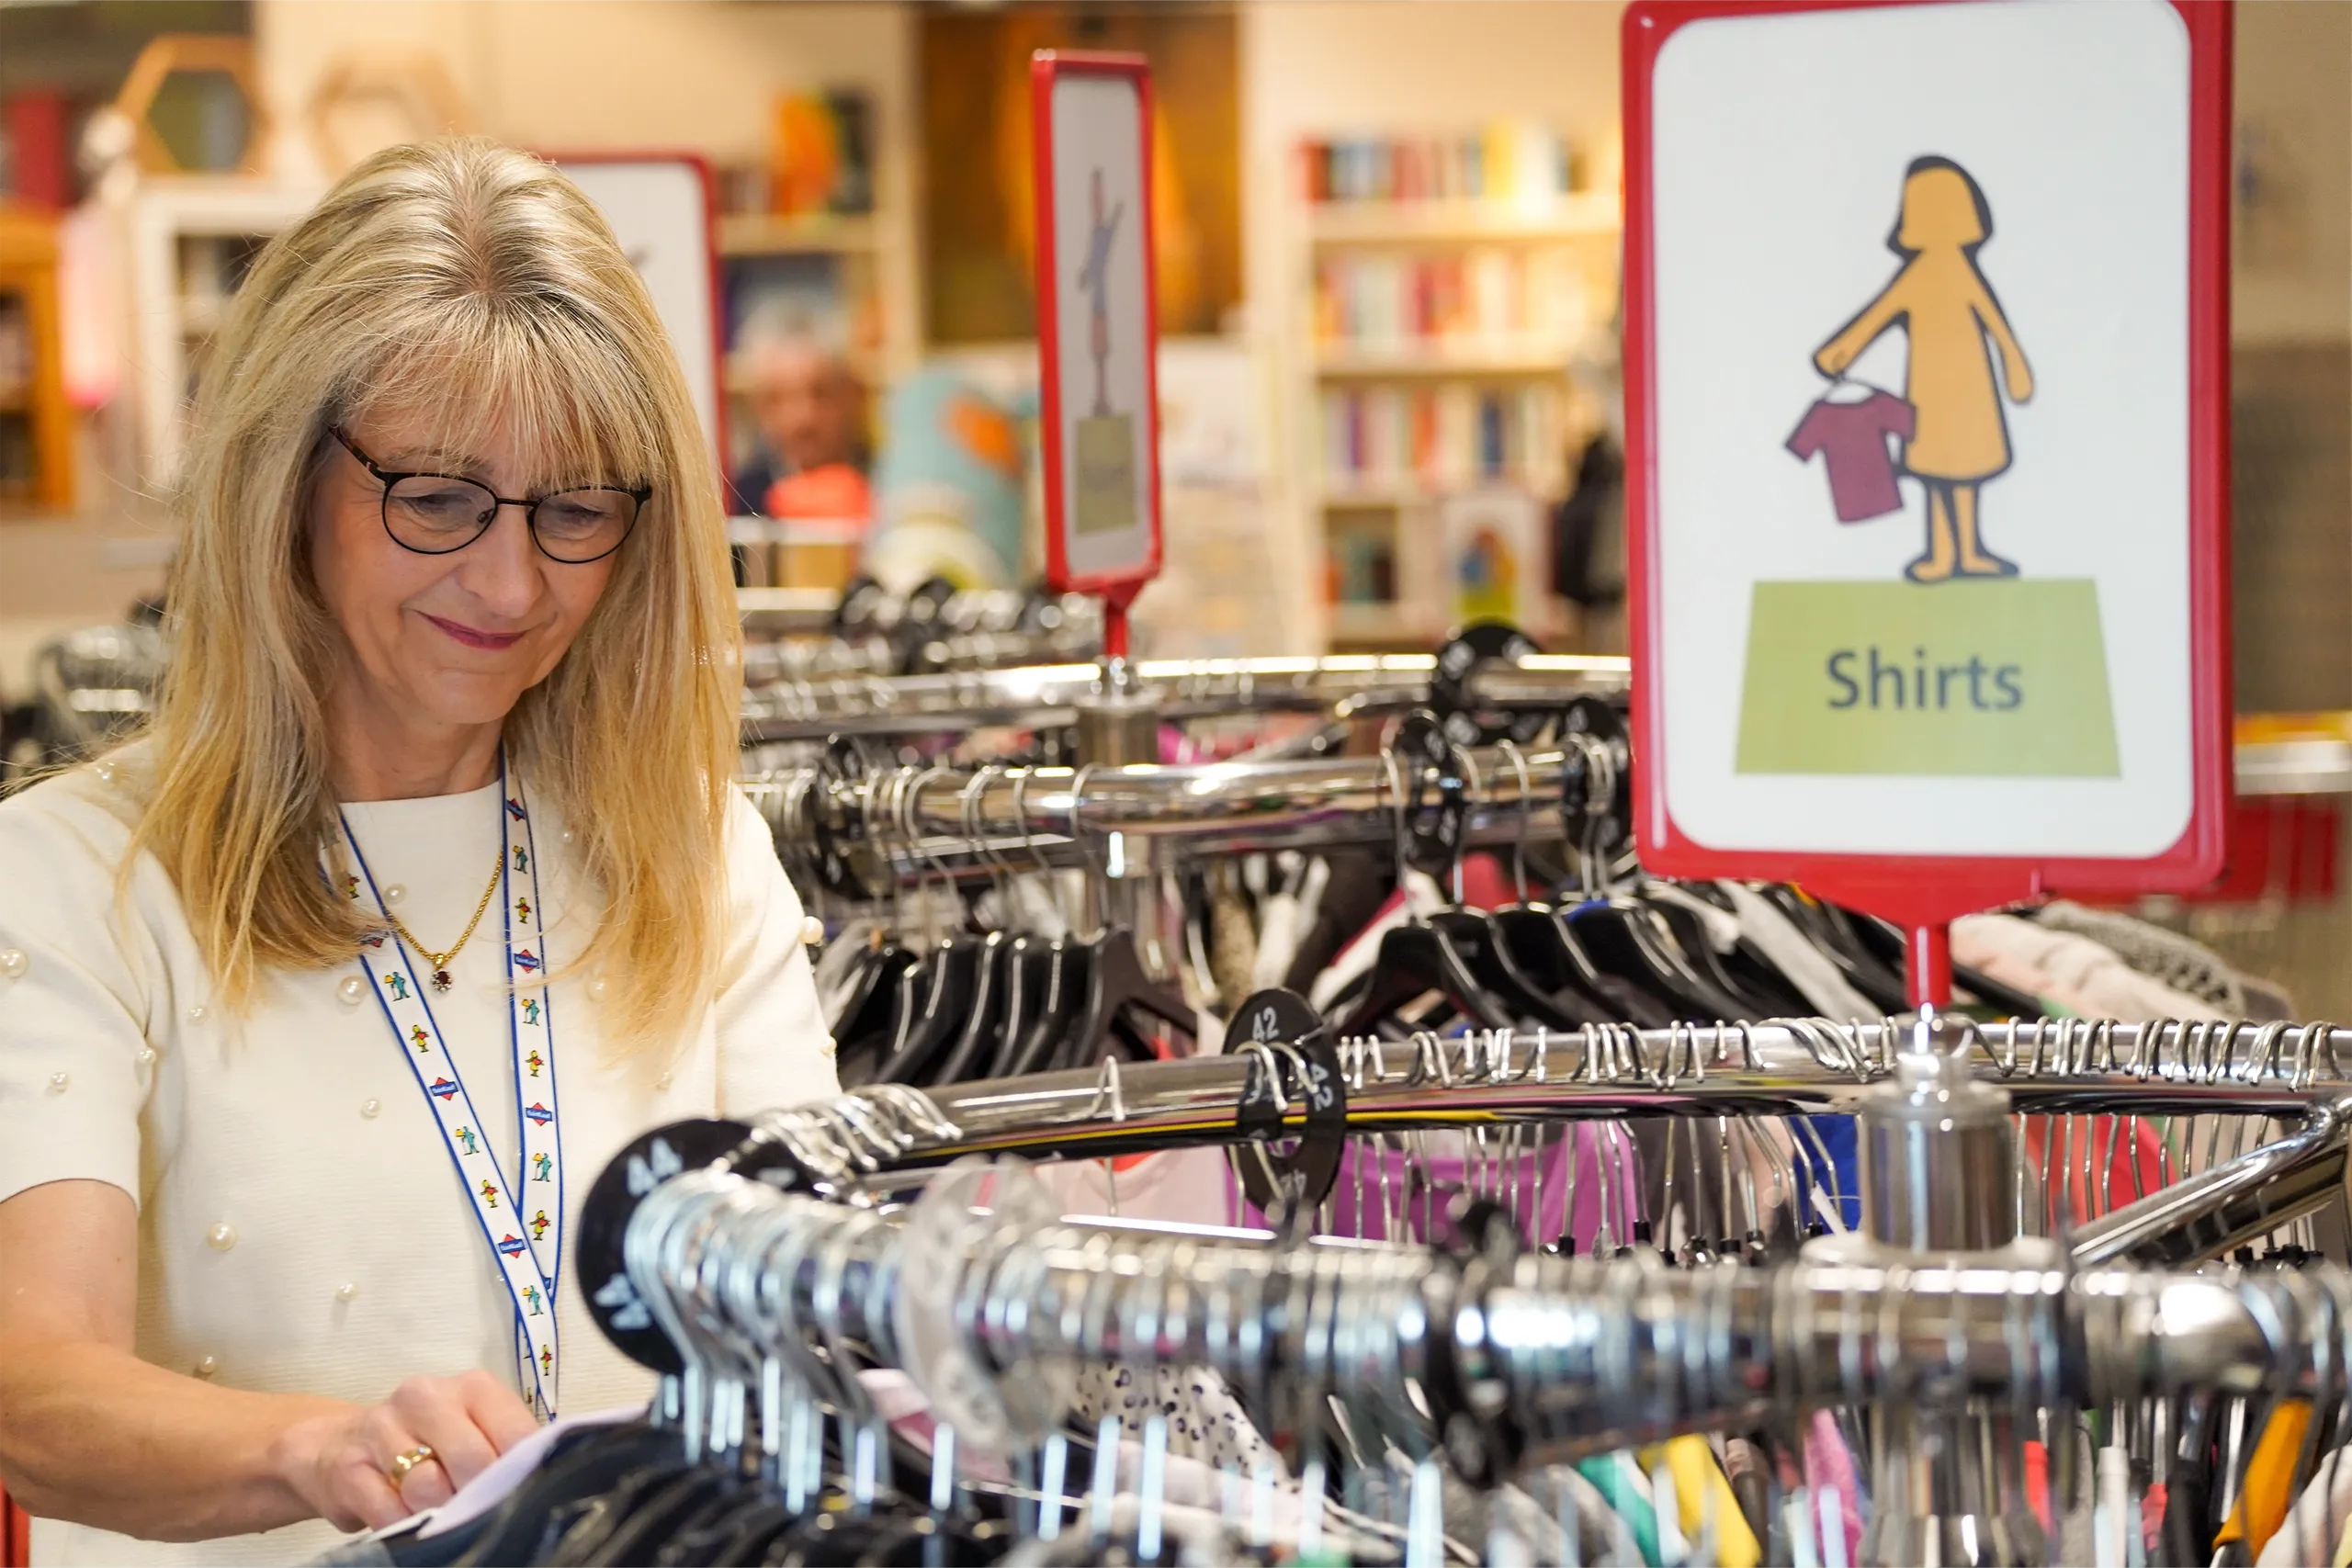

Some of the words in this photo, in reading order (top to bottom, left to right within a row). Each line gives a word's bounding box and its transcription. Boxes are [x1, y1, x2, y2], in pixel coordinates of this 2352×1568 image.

[1826, 646, 2024, 711] Shirts
[1252, 1007, 1279, 1041] 42
[1311, 1064, 1333, 1111] 42
[628, 1136, 683, 1196] 44
